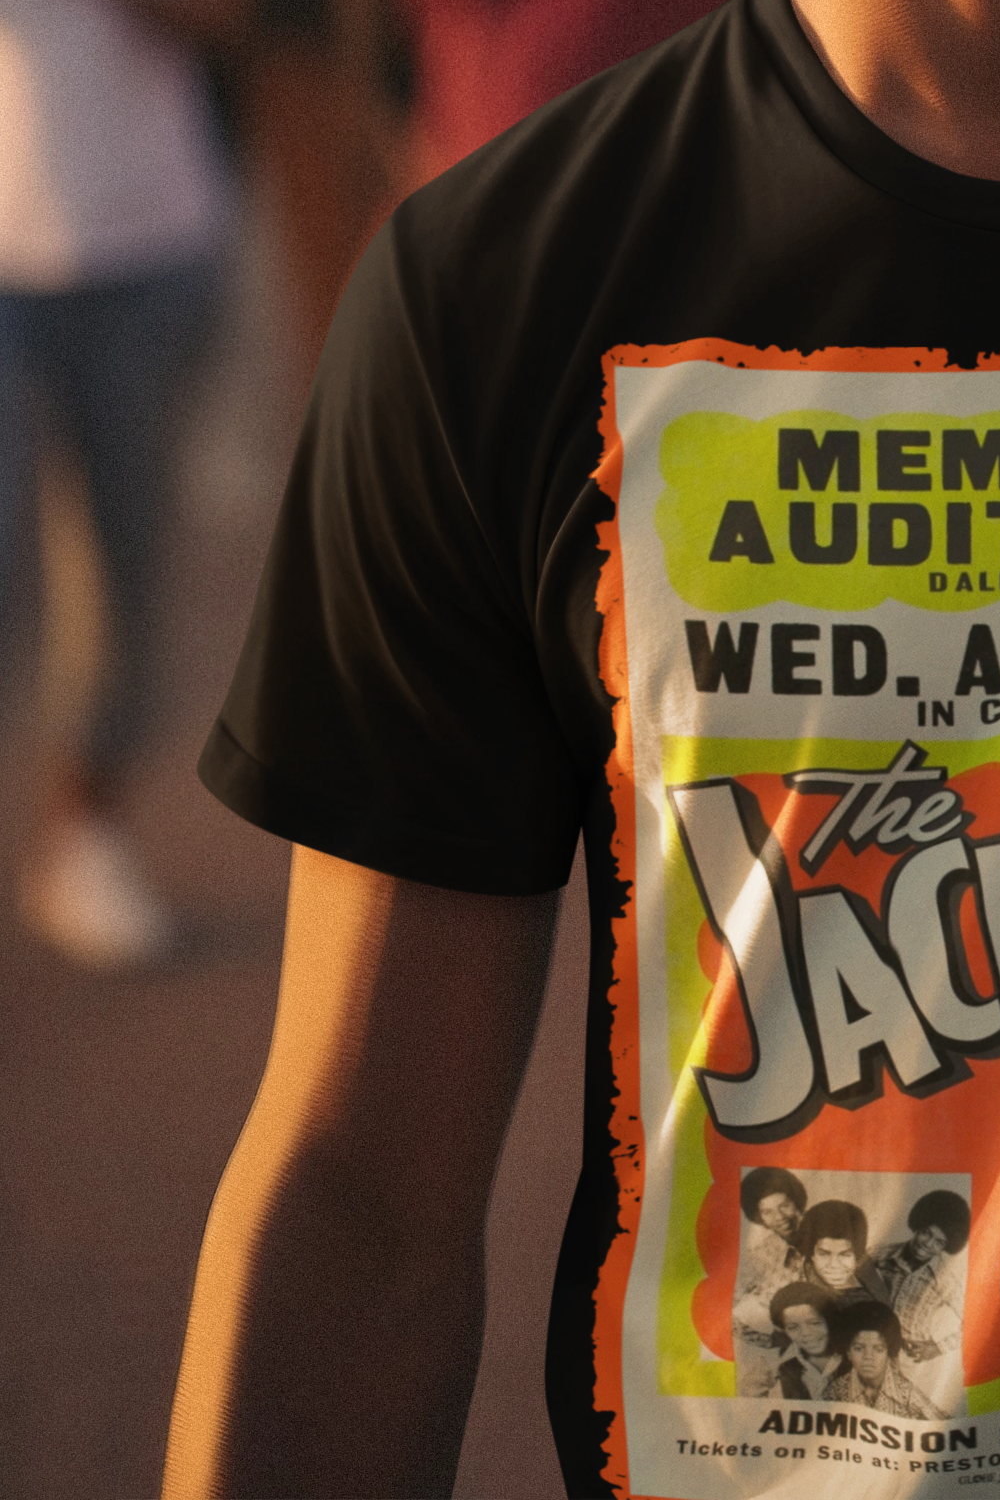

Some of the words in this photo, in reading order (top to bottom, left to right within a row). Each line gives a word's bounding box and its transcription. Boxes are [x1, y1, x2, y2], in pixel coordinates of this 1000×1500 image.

[684, 619, 921, 698] WED.
[917, 701, 955, 727] IN
[785, 738, 978, 876] The
[758, 1409, 978, 1453] ADMISSION
[676, 1440, 762, 1458] Tickets
[774, 1445, 806, 1459] on
[817, 1445, 863, 1465] Sale
[872, 1455, 900, 1472] at:
